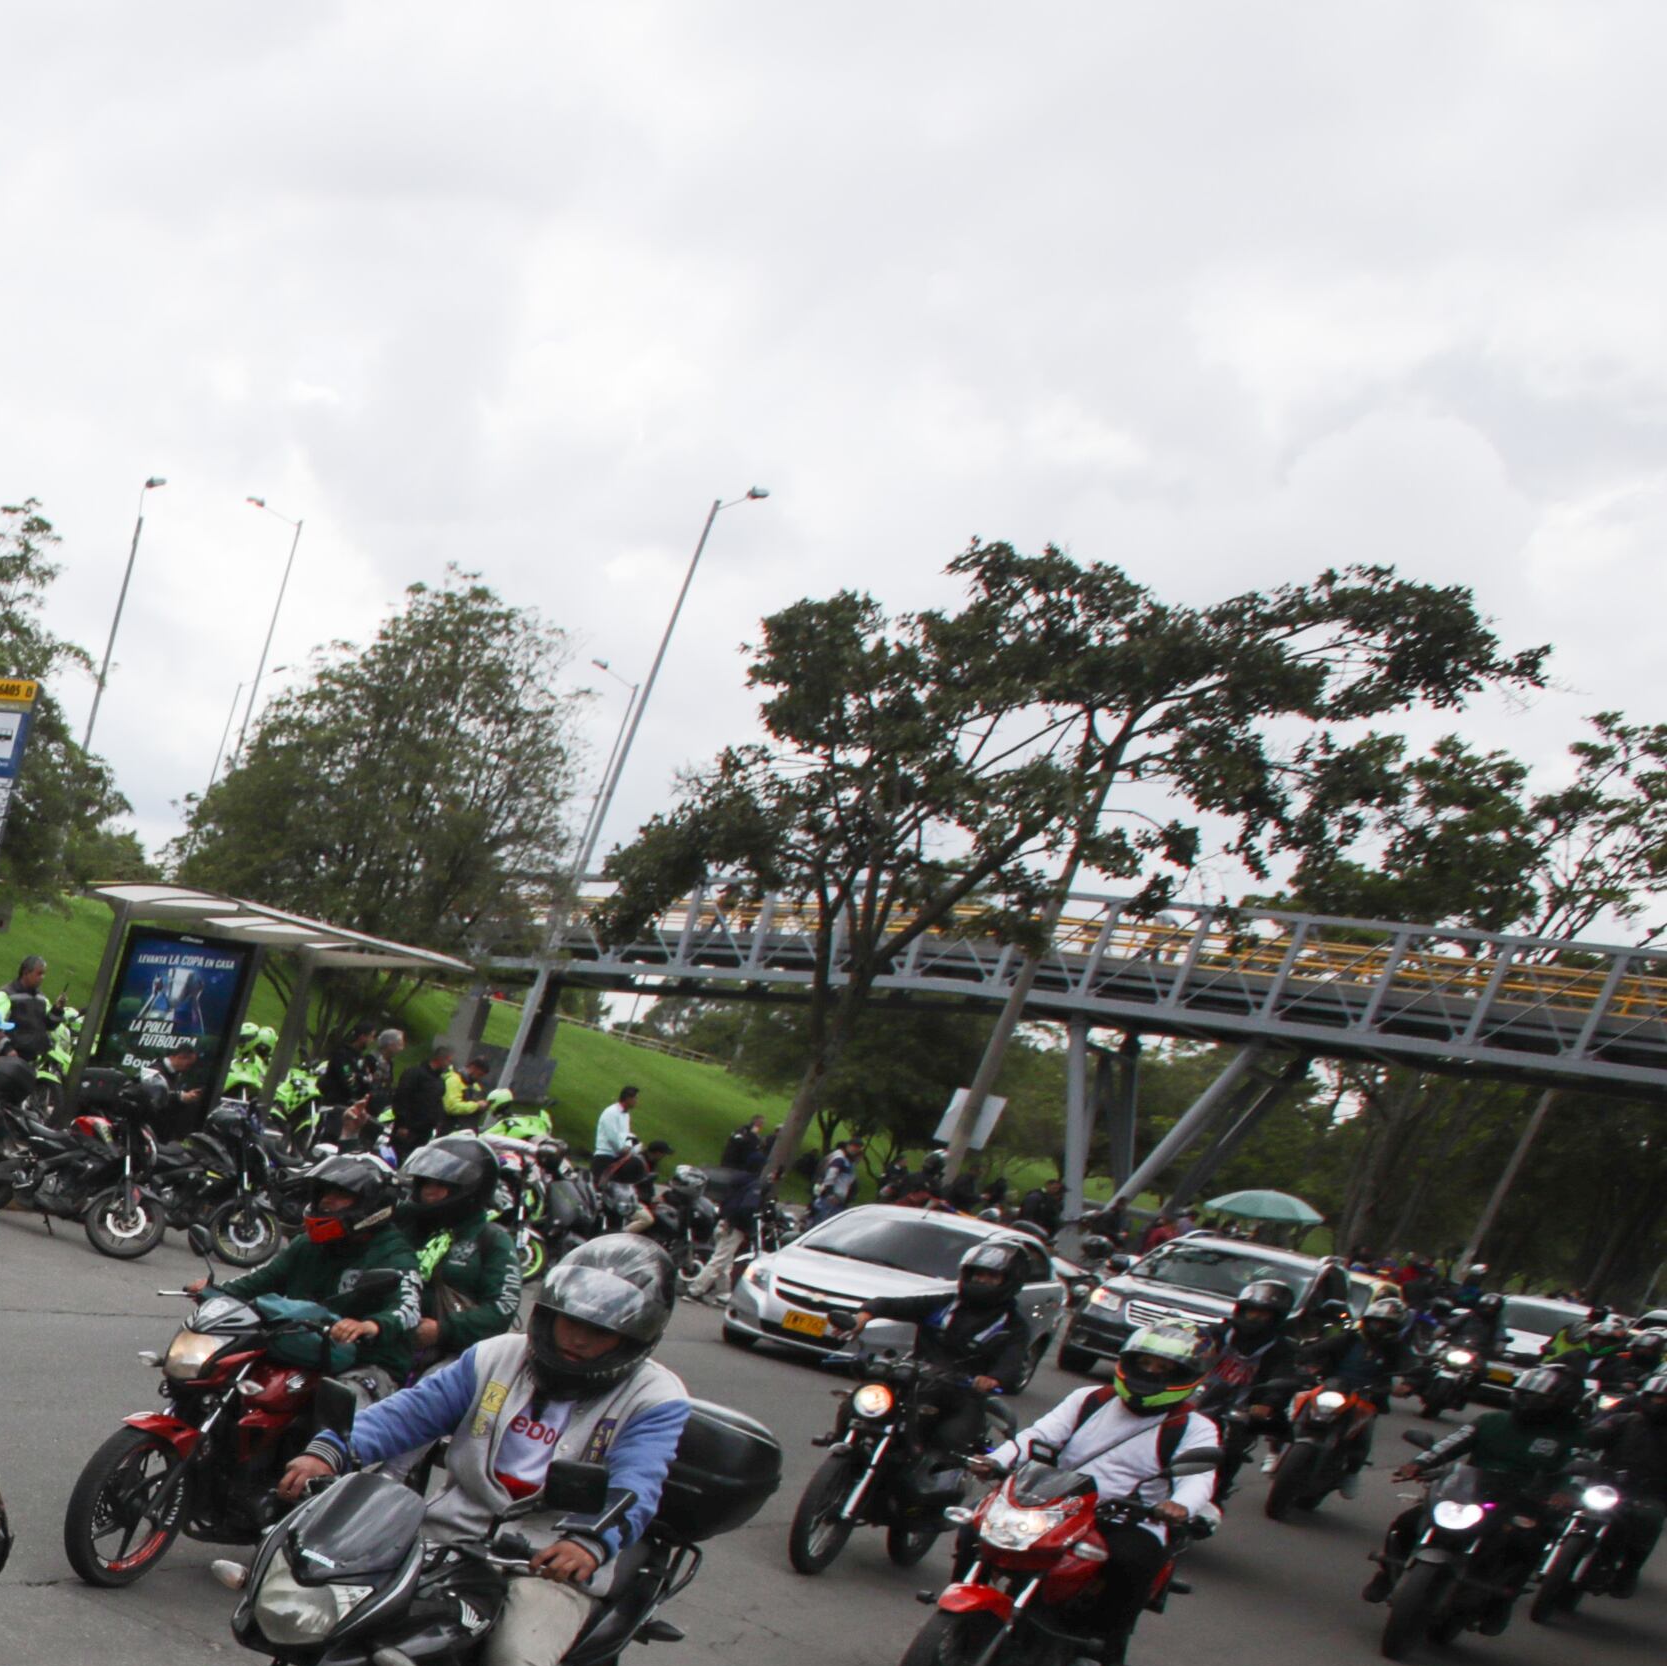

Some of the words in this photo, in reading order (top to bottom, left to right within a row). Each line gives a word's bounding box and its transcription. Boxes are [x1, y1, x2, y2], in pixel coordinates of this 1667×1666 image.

[168, 954, 179, 966] LA
[181, 955, 204, 967] COPA
[129, 1019, 143, 1032] LA
[142, 1020, 175, 1035] POLLA
[509, 1415, 556, 1445] ebo
